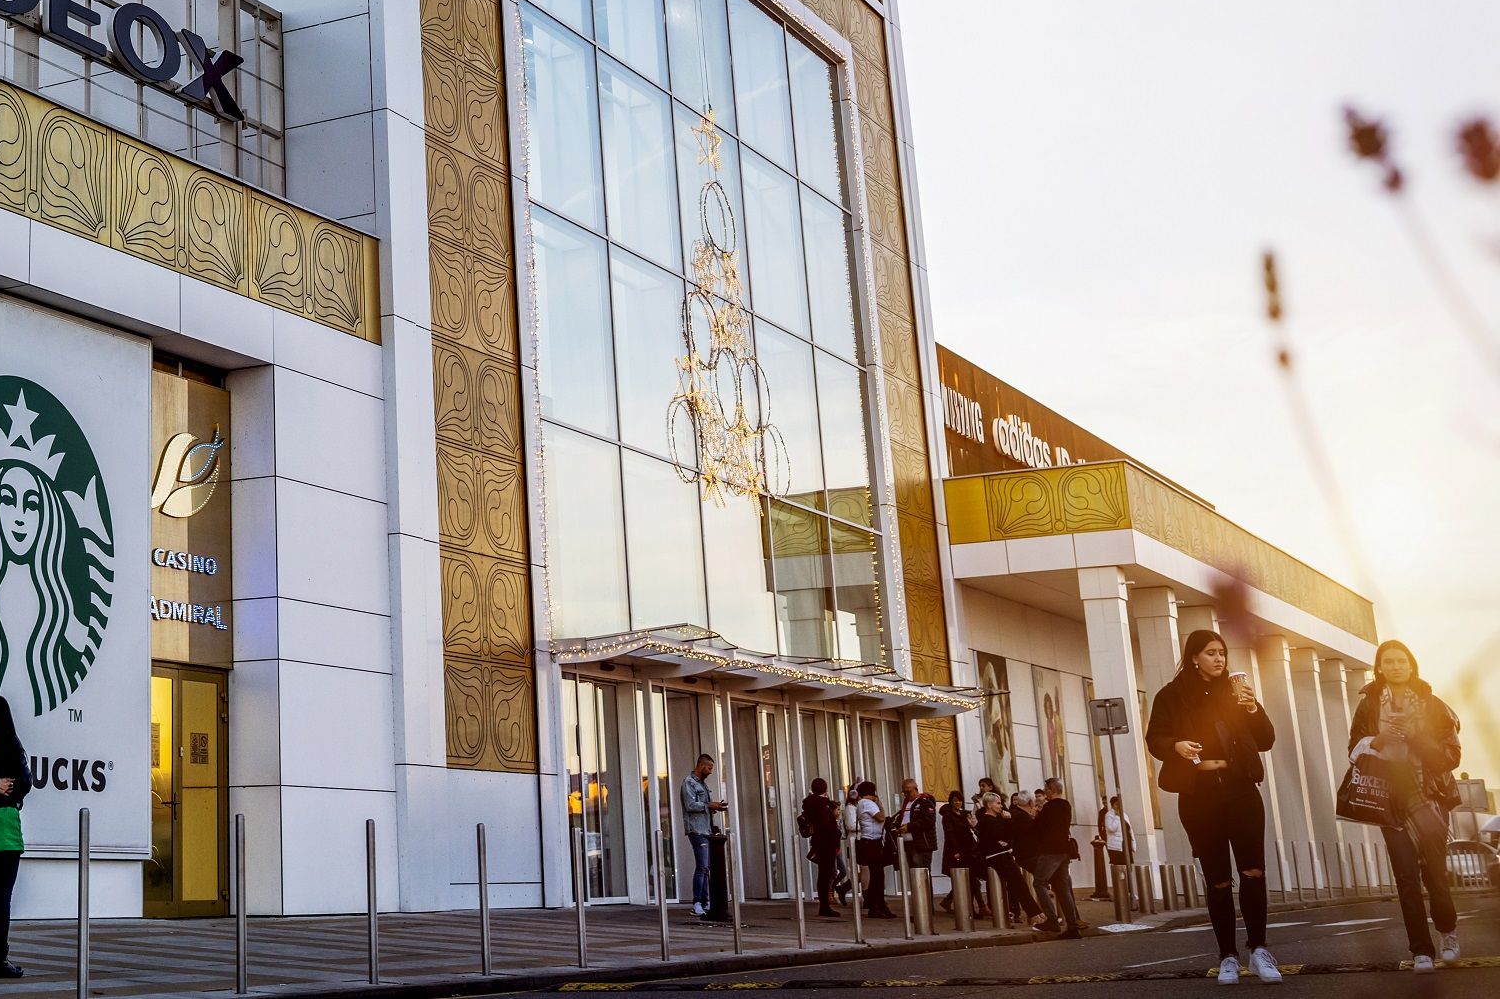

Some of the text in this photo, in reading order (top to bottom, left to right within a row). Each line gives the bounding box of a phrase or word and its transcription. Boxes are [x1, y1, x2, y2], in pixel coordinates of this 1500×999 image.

[992, 414, 1051, 468] adidas
[152, 548, 217, 575] CASINO
[150, 595, 228, 631] ADMIRAL
[68, 708, 83, 723] TM
[1352, 770, 1393, 791] BOXEU
